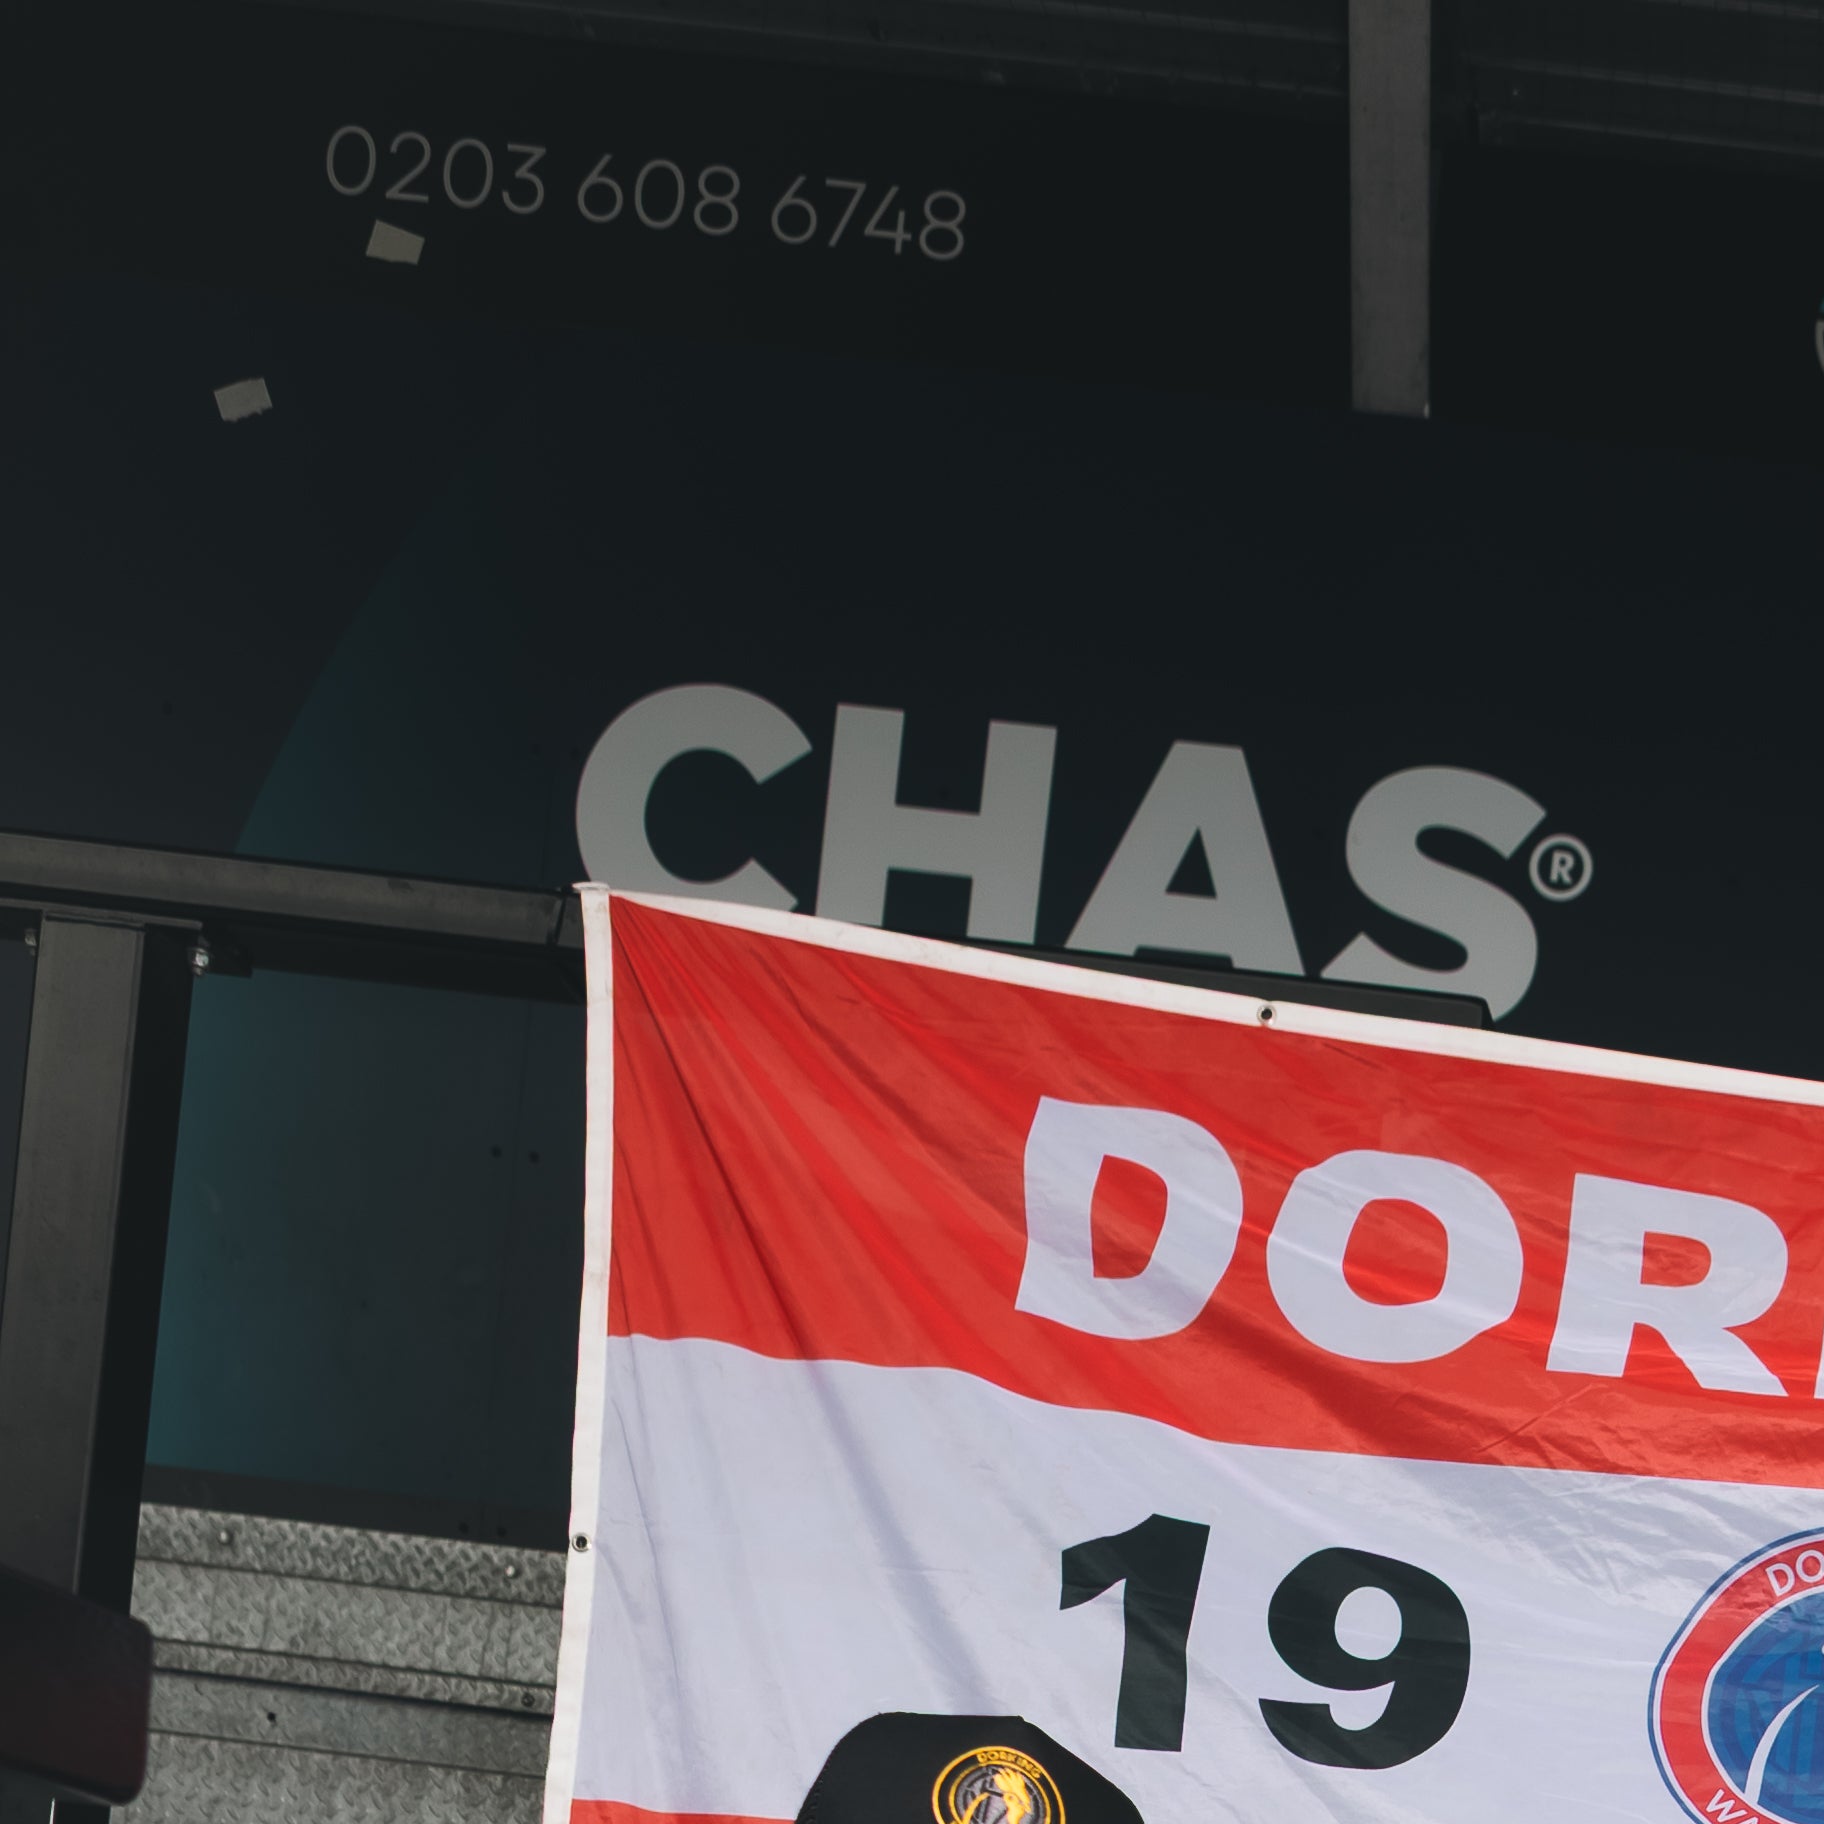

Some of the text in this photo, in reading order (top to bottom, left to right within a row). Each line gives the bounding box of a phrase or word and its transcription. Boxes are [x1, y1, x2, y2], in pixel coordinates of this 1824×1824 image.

[325, 124, 968, 261] 0203 608 6748
[1060, 1513, 1471, 1770] 19
[976, 1751, 1042, 1779] DORKING
